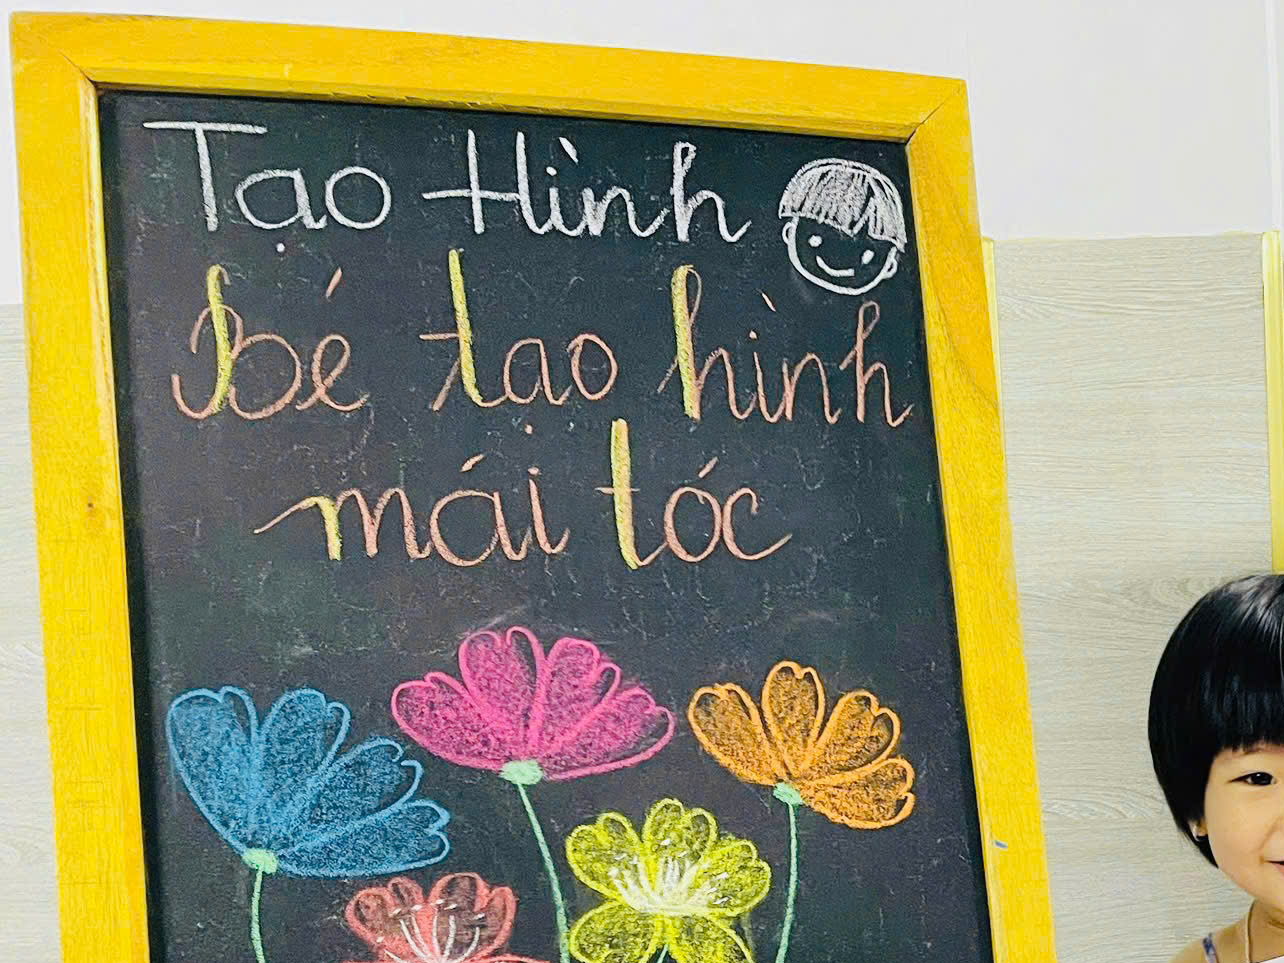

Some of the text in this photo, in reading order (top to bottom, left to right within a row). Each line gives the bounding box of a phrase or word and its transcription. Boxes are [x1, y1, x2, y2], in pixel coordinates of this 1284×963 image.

[143, 120, 752, 254] Tạo Hình
[418, 248, 618, 435] tạo
[657, 264, 914, 429] hình
[253, 417, 793, 570] mái tóc
